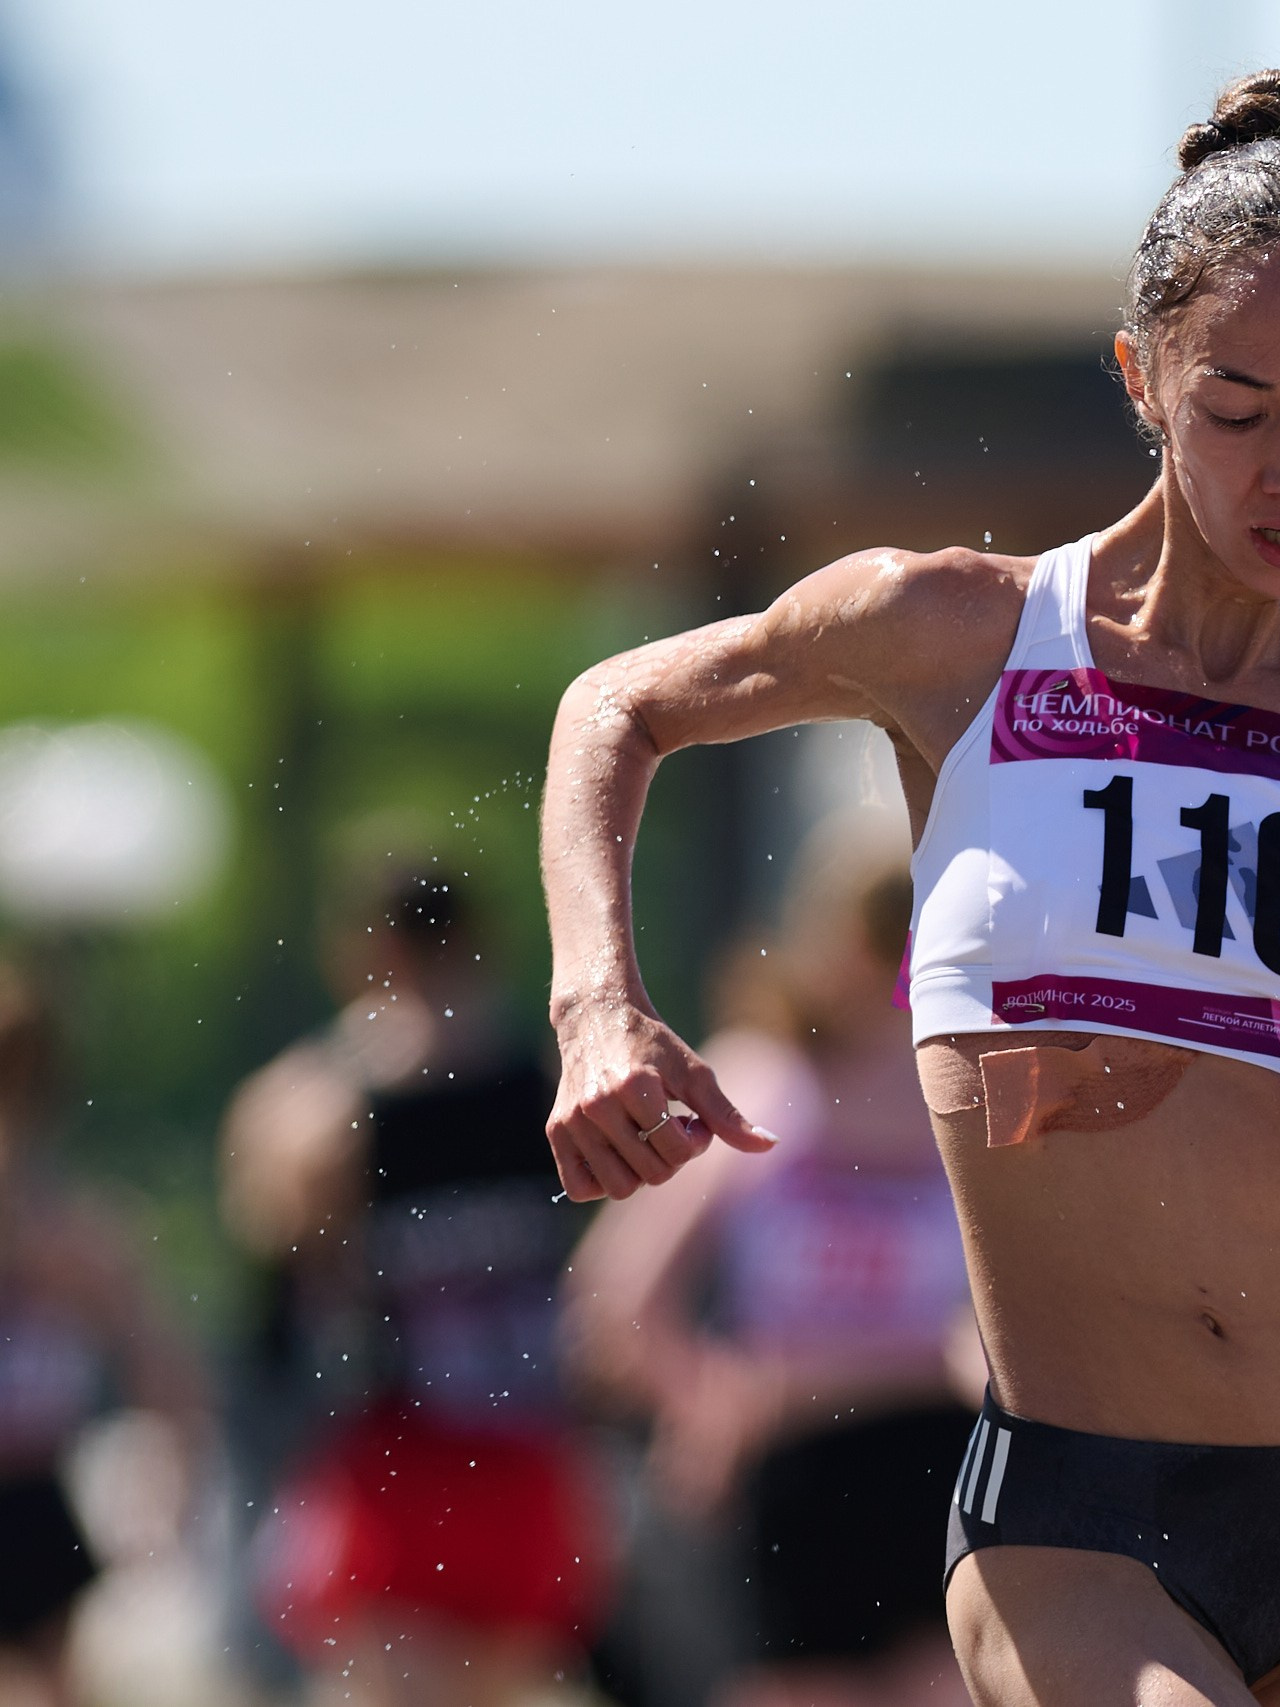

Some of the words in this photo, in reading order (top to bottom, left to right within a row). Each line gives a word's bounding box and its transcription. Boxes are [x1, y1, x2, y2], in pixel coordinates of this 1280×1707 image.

[1012, 717, 1043, 734] по
[1051, 717, 1139, 736] ходьбе
[1016, 692, 1236, 742] ЧЕМПИОНАТ
[1007, 989, 1086, 1008] ВОТКИНСК
[1090, 994, 1136, 1012] 2025
[1202, 1012, 1240, 1027] ЛЕГКОЙ
